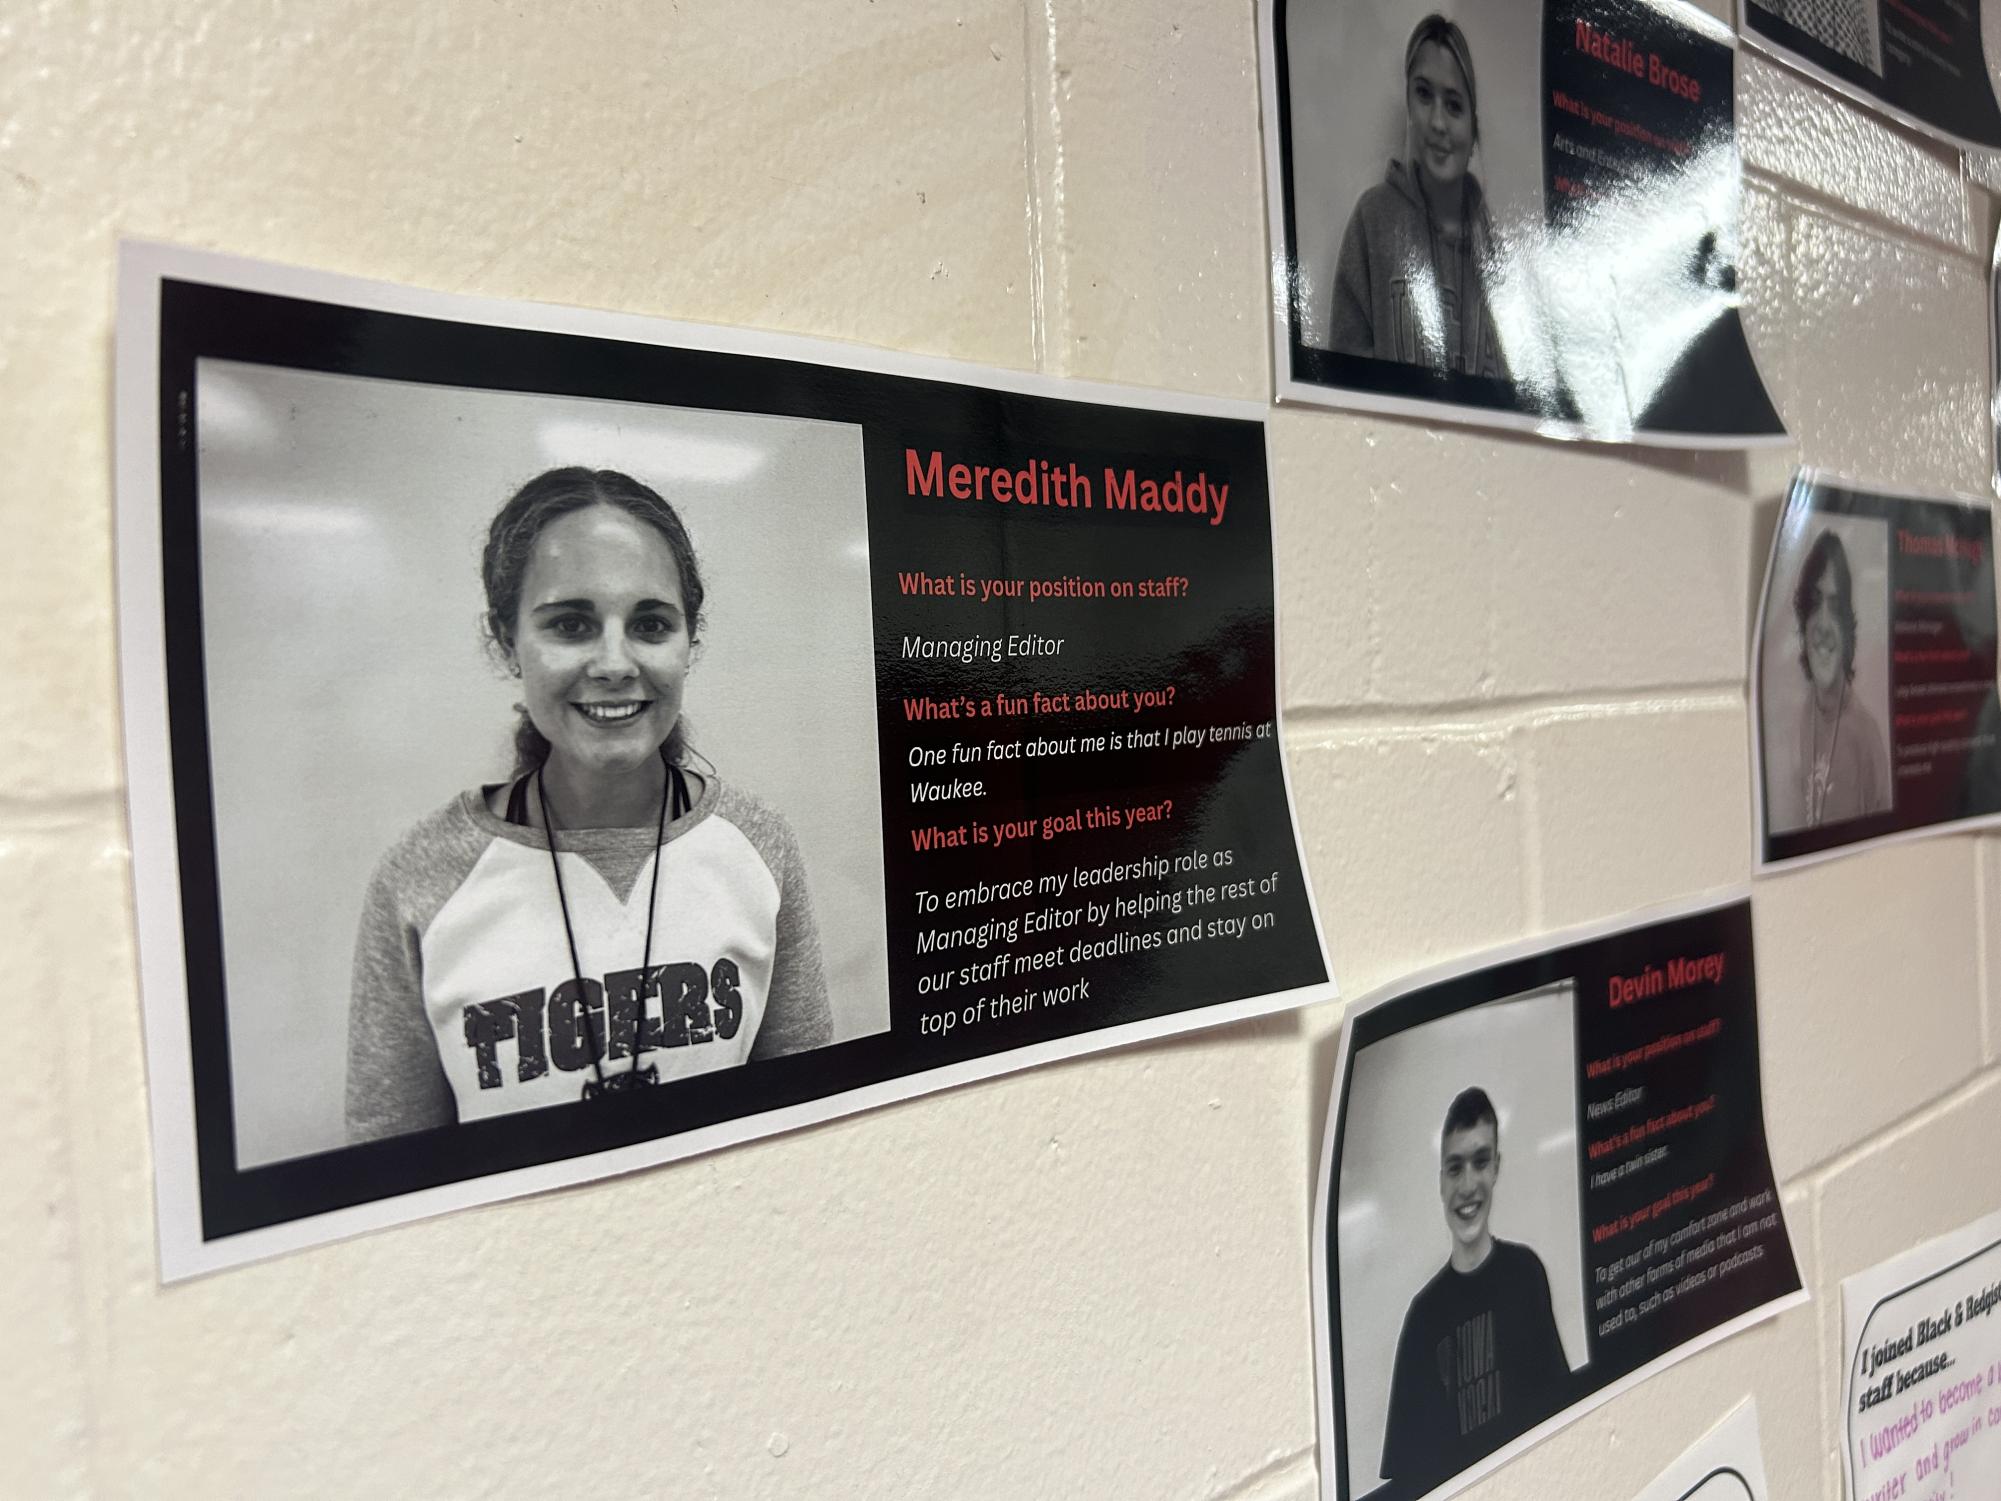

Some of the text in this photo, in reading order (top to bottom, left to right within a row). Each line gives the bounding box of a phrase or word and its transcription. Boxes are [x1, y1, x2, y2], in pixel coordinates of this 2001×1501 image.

[1575, 17, 1701, 103] Natalie Brose
[905, 448, 1230, 526] Meredith Maddy
[898, 572, 1190, 603] What is your position on staff?
[901, 633, 1065, 664] Managing Editor
[903, 686, 1176, 722] What's a fun fact about you?
[908, 721, 1272, 768] One fun fact about me is that I play tennis at
[910, 777, 988, 803] Waukee.
[911, 800, 1174, 851] What is your goal this year?
[915, 848, 1234, 914] To embrace my leadership role as
[916, 872, 1279, 955] Managing Editor by helping the rest of
[917, 910, 1275, 994] our staff meet deadlines and stay on
[1609, 952, 1725, 1008] Devin Morey
[463, 957, 743, 1091] TIGERS
[919, 978, 1090, 1036] top of their work
[1587, 1098, 1615, 1121] News
[1595, 1169, 1617, 1188] have
[1595, 1266, 1607, 1283] To
[1607, 1257, 1625, 1282] get
[1642, 1239, 1656, 1259] of
[1655, 1236, 1670, 1254] my
[1669, 1216, 1708, 1246] comfort
[1707, 1208, 1729, 1229] zone
[1729, 1196, 1749, 1219] and
[1748, 1188, 1772, 1210] work
[1595, 1285, 1618, 1311] with
[1618, 1272, 1645, 1298] other
[1646, 1259, 1675, 1285] forms
[1674, 1249, 1688, 1269] of
[1686, 1238, 1715, 1264] media
[1716, 1229, 1737, 1250] that
[1742, 1220, 1758, 1238] am
[1759, 1212, 1778, 1232] not
[1599, 1308, 1623, 1337] used
[1638, 1290, 1662, 1315] such
[1662, 1285, 1676, 1302] as
[1675, 1269, 1707, 1296] videos
[1706, 1264, 1719, 1281] or
[1719, 1244, 1764, 1279] podcasts
[1860, 1347, 1869, 1376] I
[1868, 1325, 1913, 1379] joined
[1916, 1307, 1952, 1347] Black
[1954, 1300, 1964, 1328] &
[1859, 1372, 1894, 1414] staff
[1895, 1351, 1956, 1396] because...
[1860, 1437, 1867, 1469] I
[1869, 1402, 1919, 1461] wanted
[1919, 1398, 1934, 1424] to
[1938, 1372, 1983, 1414] become
[1987, 1364, 1995, 1387] a
[1915, 1441, 1939, 1482] and
[1943, 1426, 1970, 1473] grow
[1971, 1415, 1982, 1435] in
